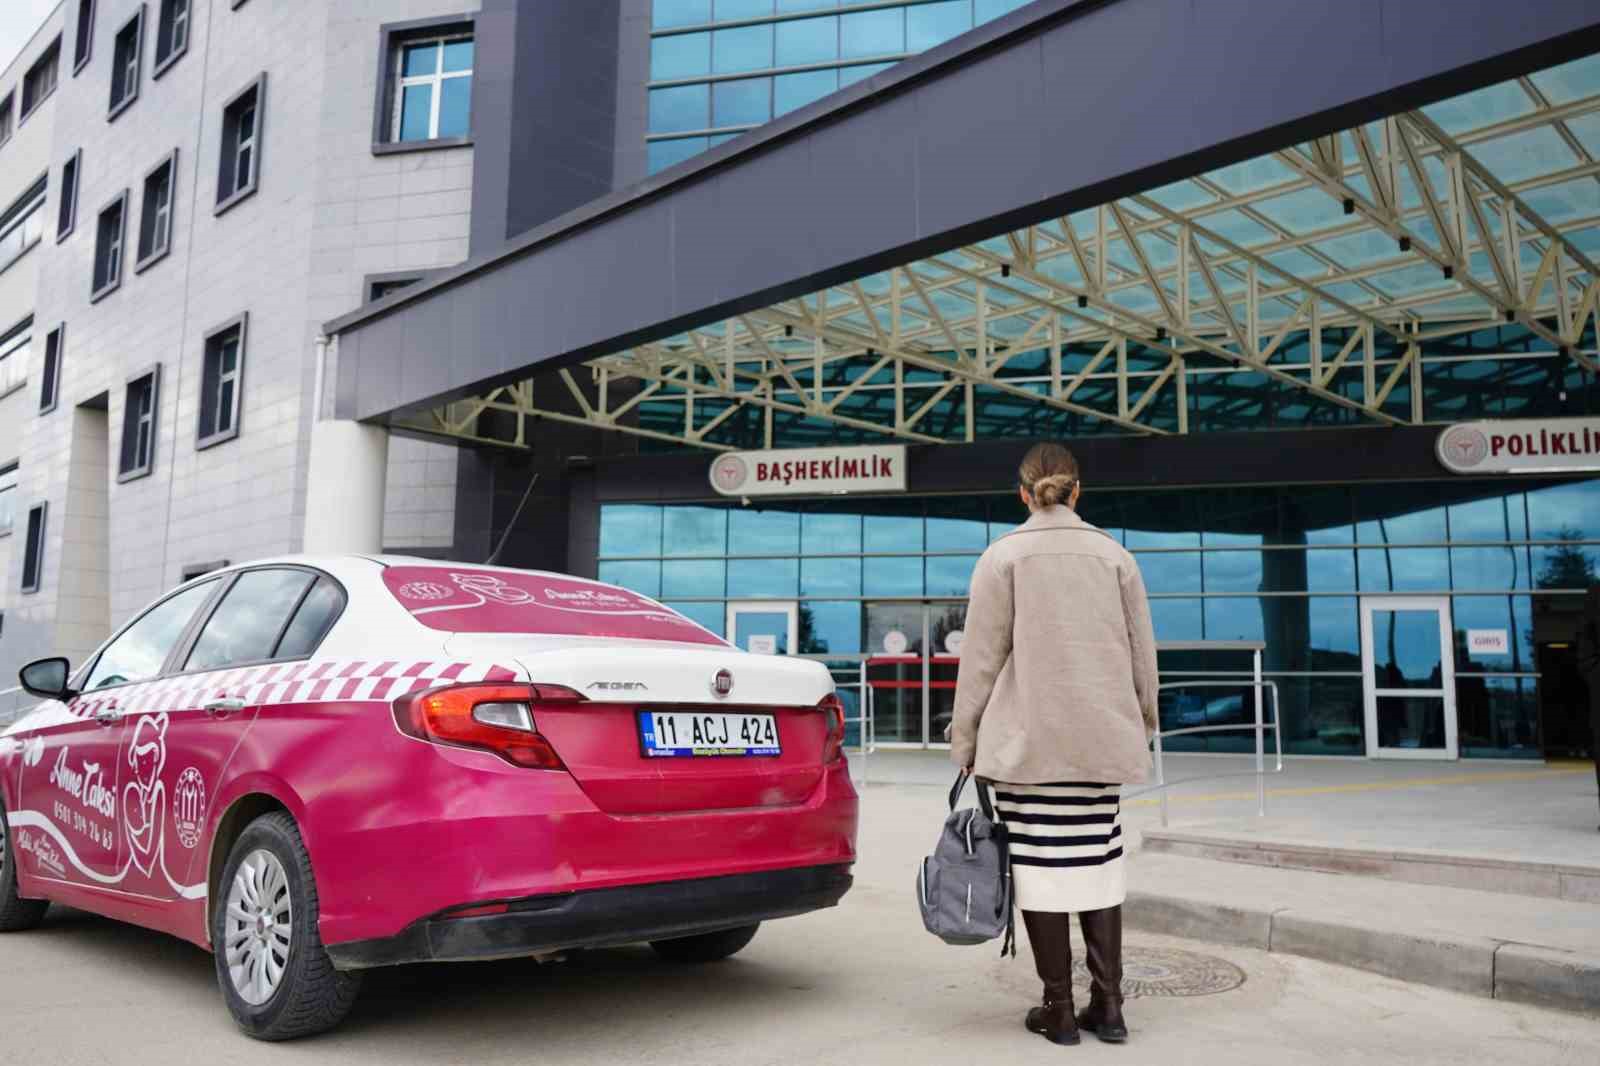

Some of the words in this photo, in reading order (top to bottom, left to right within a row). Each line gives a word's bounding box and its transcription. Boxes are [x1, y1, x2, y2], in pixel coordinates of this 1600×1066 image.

[756, 454, 893, 486] BAŞHEKİMLİK
[657, 716, 677, 745] 11
[692, 716, 729, 745] ACJ
[740, 717, 774, 745] 424
[49, 745, 83, 799] Anne
[82, 760, 117, 819] Taksi
